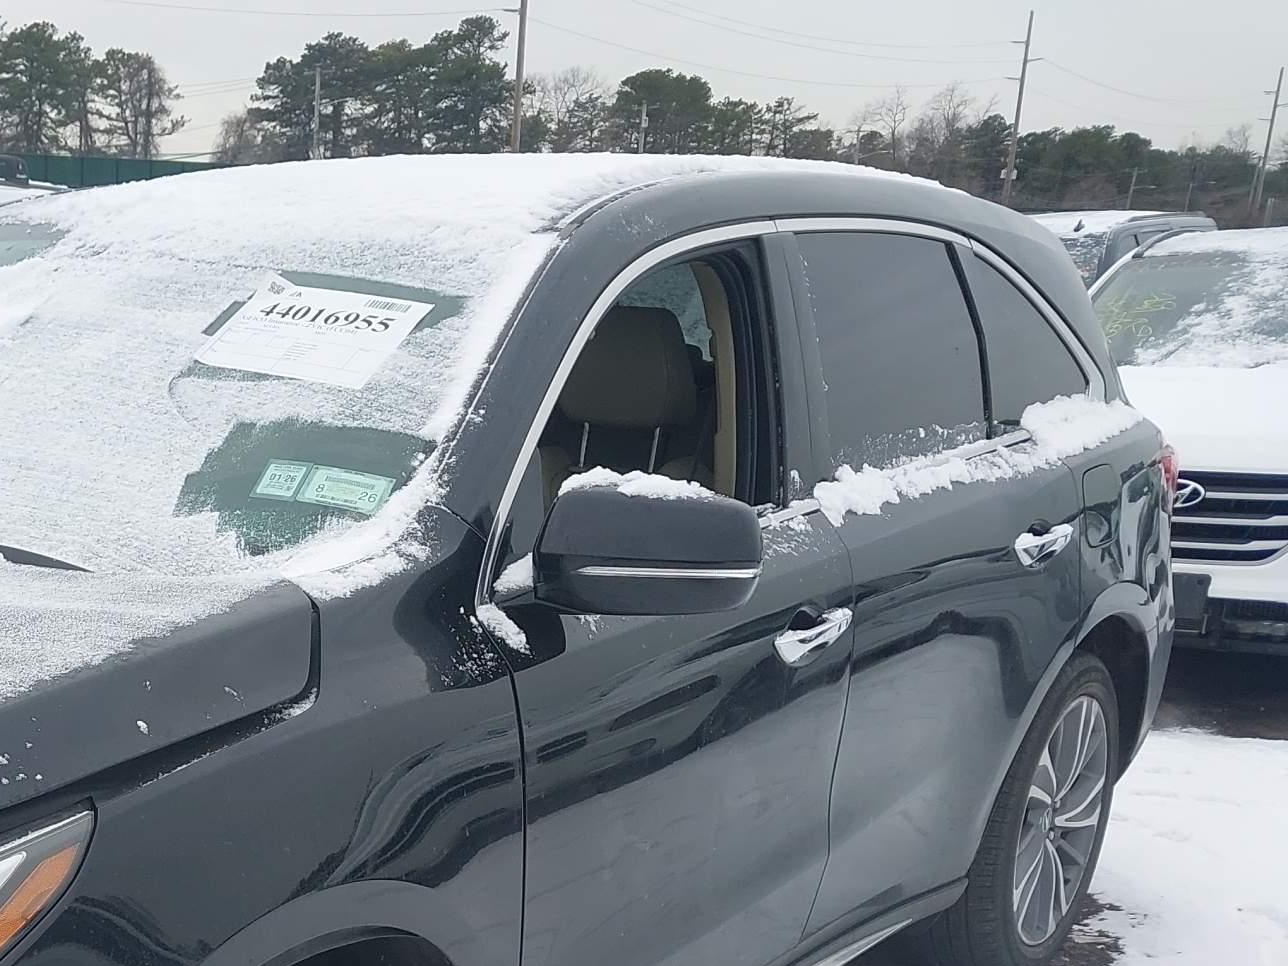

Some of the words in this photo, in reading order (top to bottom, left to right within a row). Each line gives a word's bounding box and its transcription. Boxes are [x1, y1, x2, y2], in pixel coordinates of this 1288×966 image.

[259, 302, 397, 333] 44016955
[315, 483, 325, 493] 8
[358, 491, 378, 503] 26
